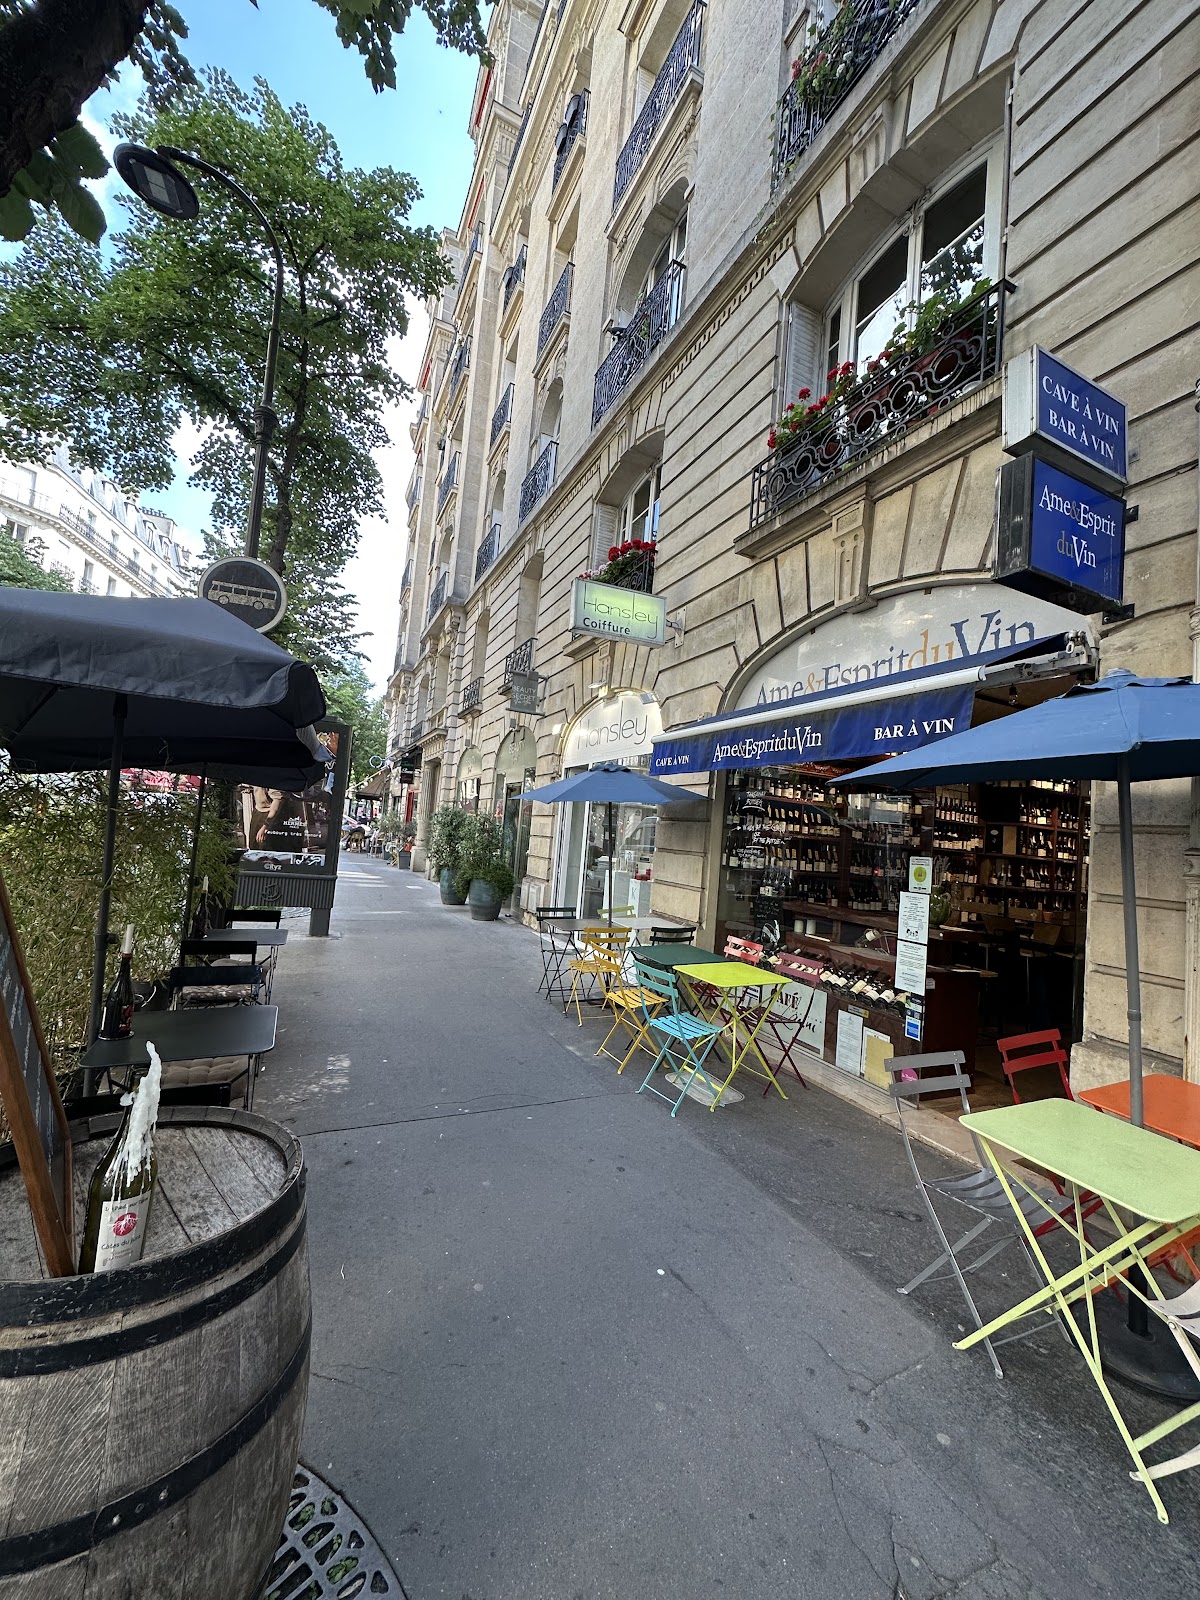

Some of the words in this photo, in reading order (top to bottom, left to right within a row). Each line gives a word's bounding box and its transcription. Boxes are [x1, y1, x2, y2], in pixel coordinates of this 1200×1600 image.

[1042, 375, 1080, 413] CAVE
[1083, 396, 1093, 421] À
[1096, 407, 1120, 436] VIN
[1049, 408, 1077, 440] BAR
[1079, 425, 1089, 447] À
[1092, 436, 1114, 460] VIN
[583, 582, 659, 639] Hansley
[583, 617, 631, 635] Coiffure
[512, 684, 537, 694] BEAUTY
[577, 701, 648, 749] Hansley
[873, 725, 904, 741] BAR
[907, 720, 919, 738] À
[923, 717, 955, 734] VIN
[655, 757, 672, 767] CAVE
[673, 754, 679, 766] À
[678, 755, 690, 764] VIN
[773, 990, 802, 1009] AFÉ
